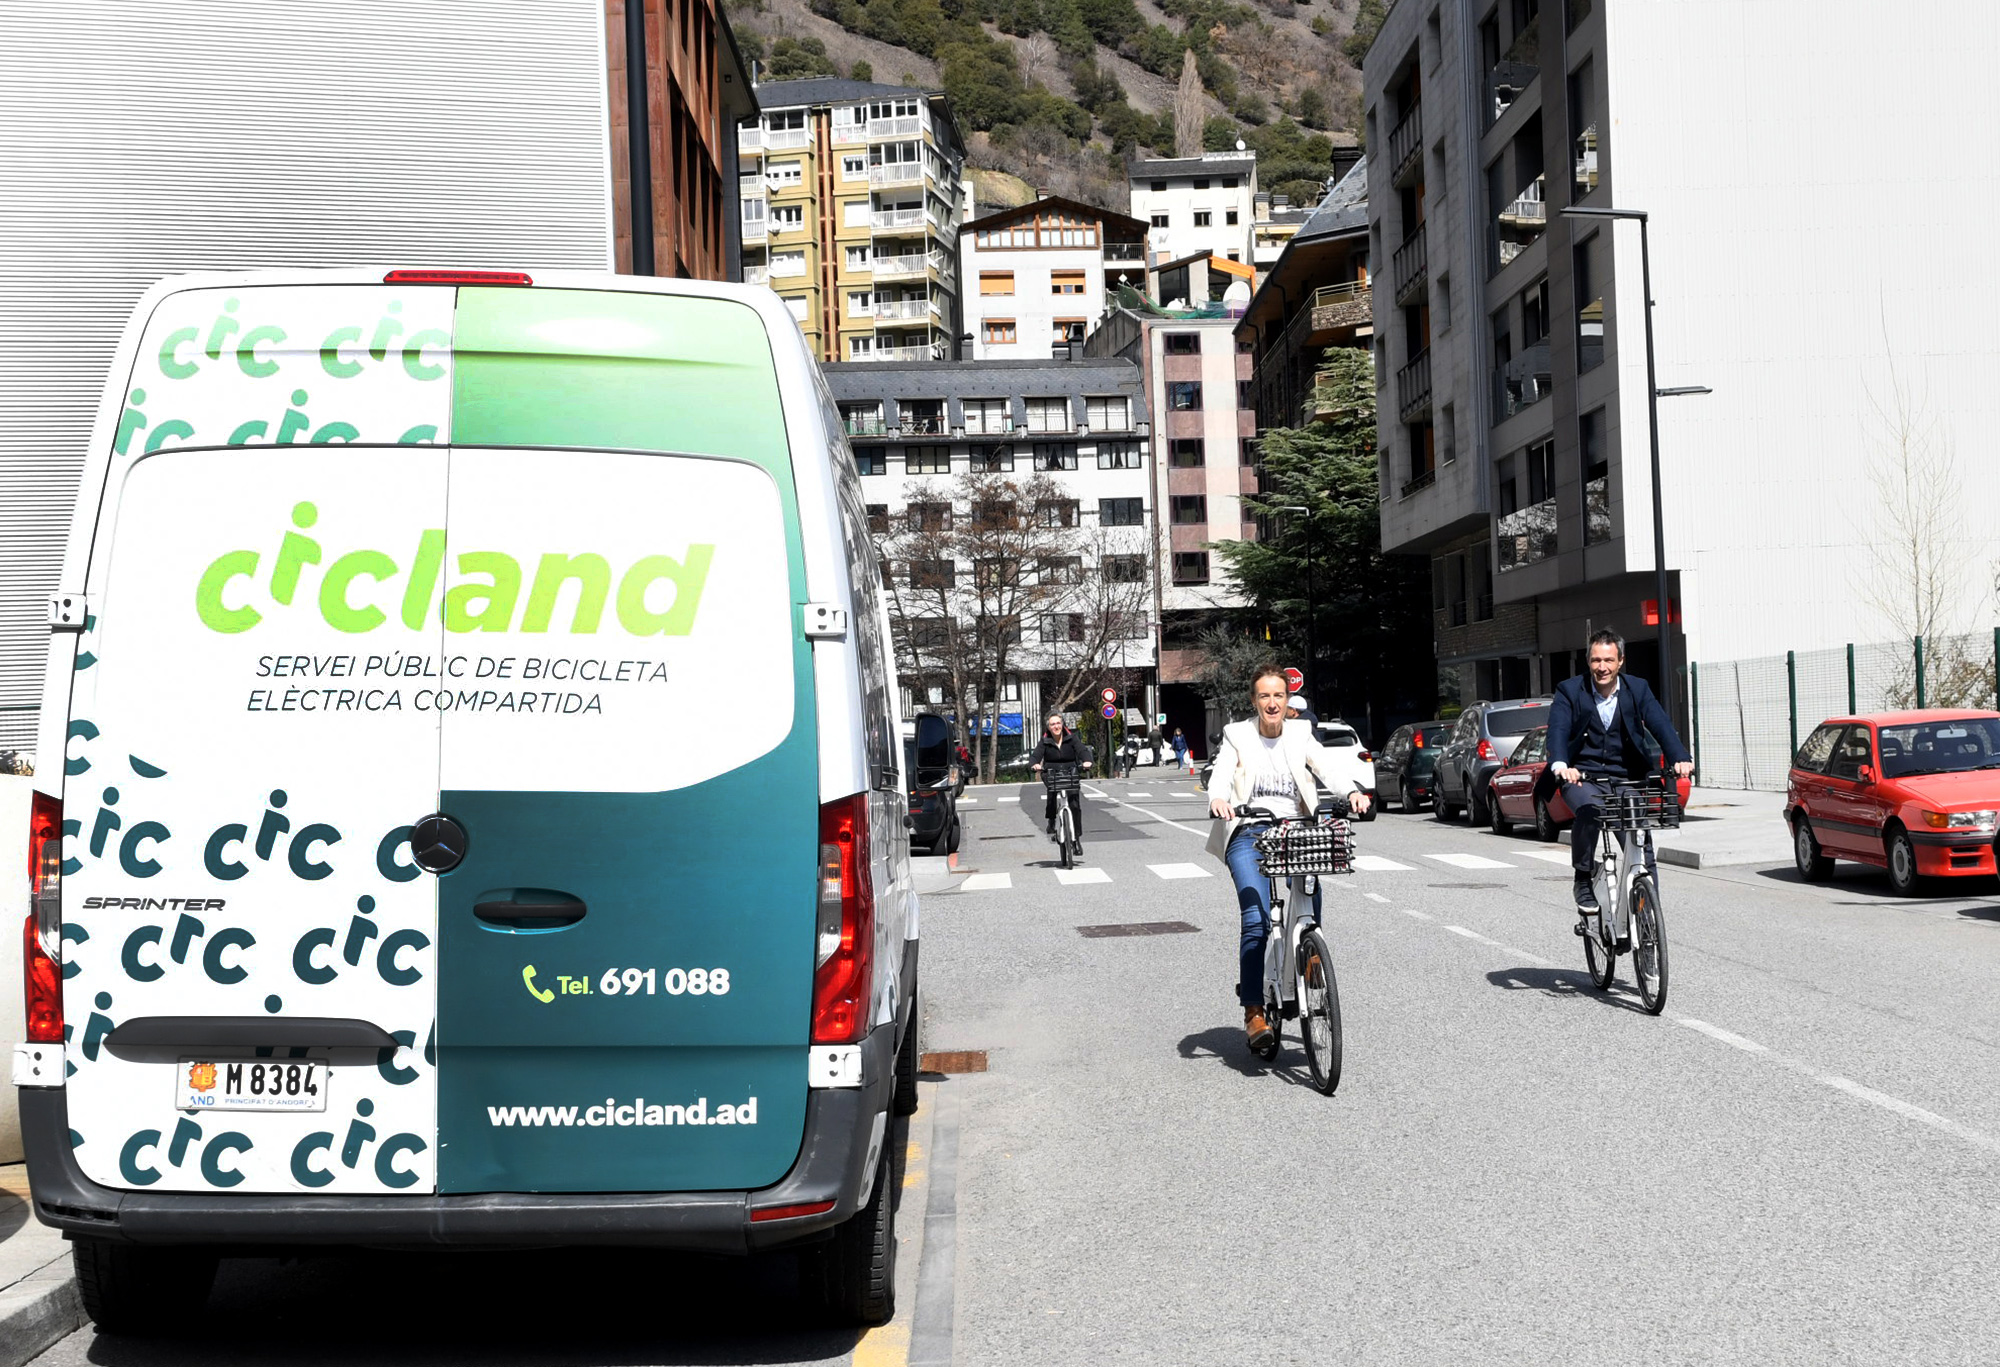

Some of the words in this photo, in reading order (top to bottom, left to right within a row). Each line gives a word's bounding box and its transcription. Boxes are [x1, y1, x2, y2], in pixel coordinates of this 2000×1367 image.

[195, 501, 715, 637] cicland
[255, 655, 357, 678] SERVEI
[364, 650, 468, 678] PÚBLIC
[475, 656, 517, 679] DE
[522, 657, 668, 683] BICICLETA
[247, 684, 402, 713] ELÈCTRICA
[414, 688, 602, 715] COMPARTIDA
[203, 788, 343, 881] cic
[82, 896, 226, 912] SPRINTER
[292, 894, 432, 986] cic
[557, 975, 594, 995] Tel.
[599, 967, 656, 996] 691
[665, 967, 731, 996] 088
[226, 1063, 243, 1095] M
[250, 1064, 318, 1097] 8384
[269, 1099, 316, 1107] D'ANDOR
[487, 1096, 758, 1127] www.cicland.ad
[290, 1097, 428, 1189] cic
